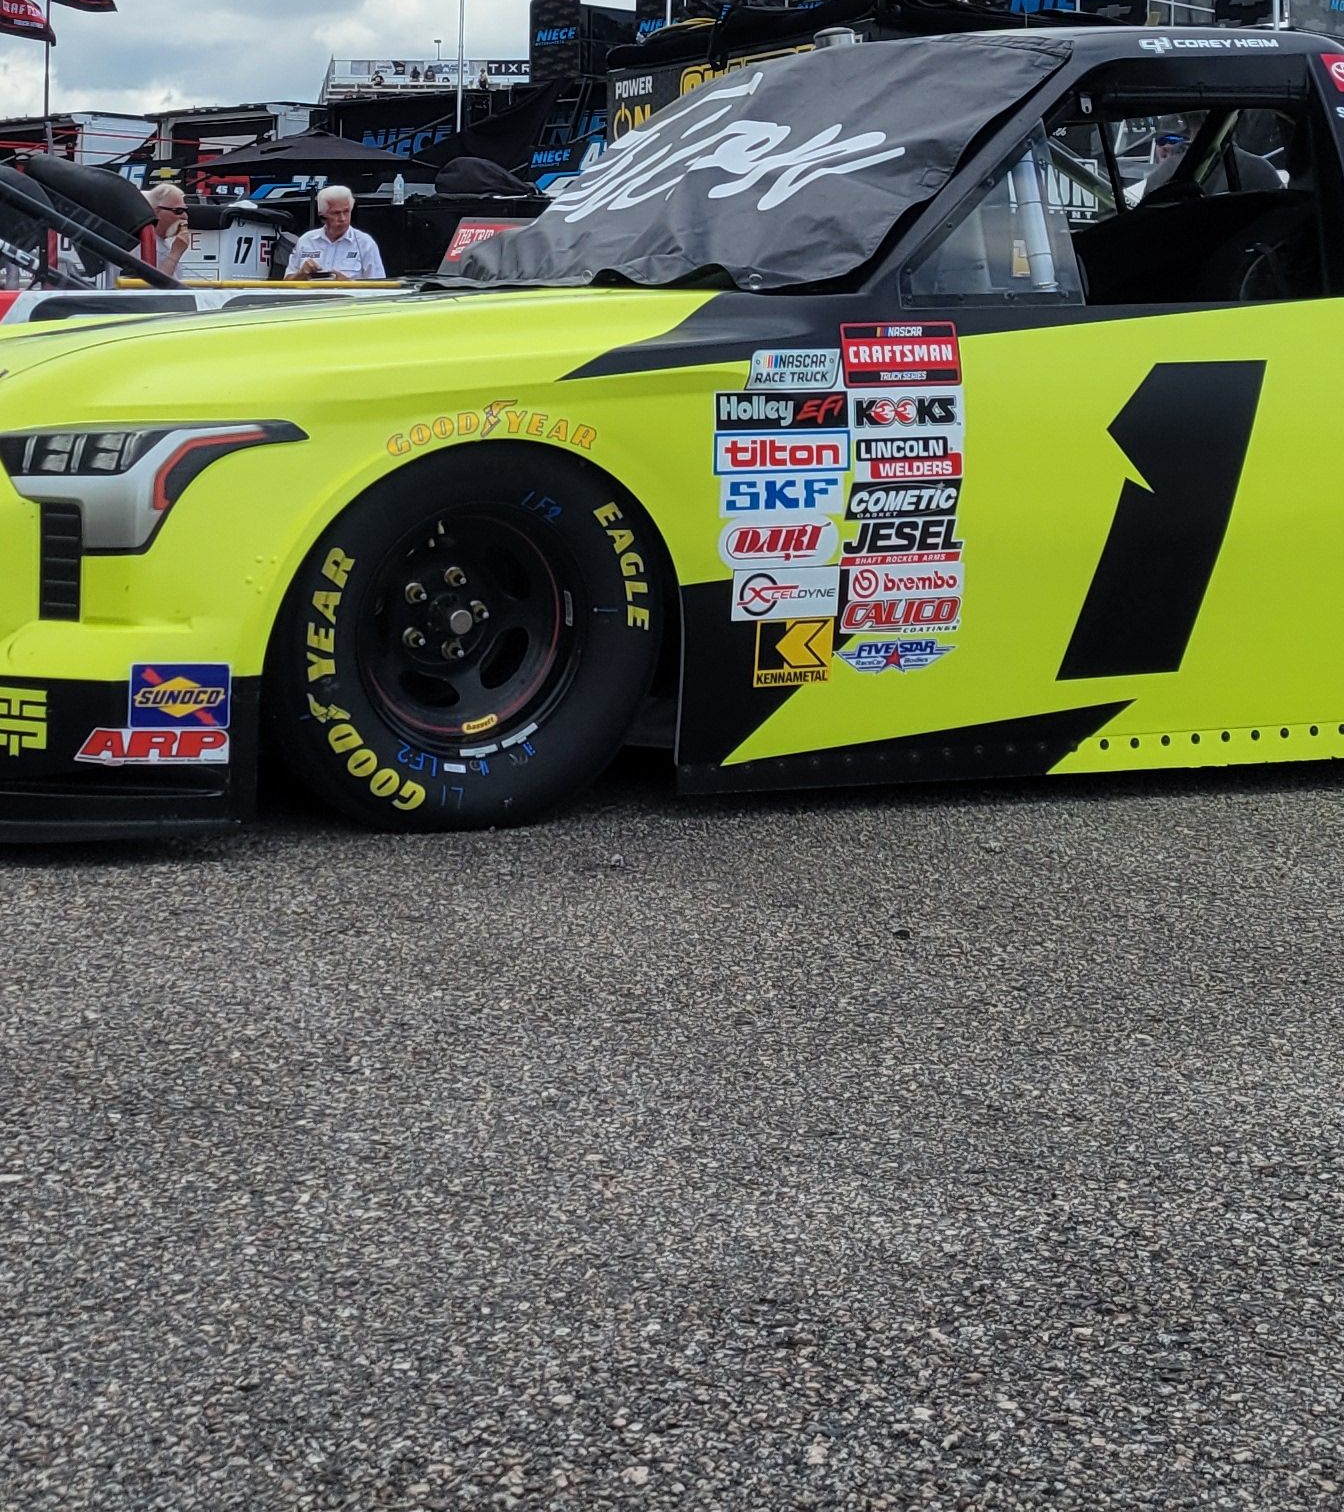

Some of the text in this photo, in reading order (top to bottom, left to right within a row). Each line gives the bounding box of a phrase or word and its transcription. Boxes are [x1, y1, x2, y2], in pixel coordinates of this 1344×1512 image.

[536, 27, 577, 42] NIECE
[1173, 38, 1279, 49] COREY HEIM
[615, 75, 654, 101] POWER
[532, 149, 571, 164] NIECE
[234, 236, 254, 264] 17
[887, 326, 923, 337] NASCAR
[778, 354, 826, 368] NASCAR
[848, 344, 953, 364] CRAFTSMAN
[755, 371, 829, 384] RACE TRUCK
[880, 371, 927, 381] TRUCK SERIES
[719, 394, 844, 426] Holley EFI
[854, 396, 957, 428] KOOKS
[387, 400, 597, 456] GOODYEAR
[724, 439, 840, 468] tilton
[860, 439, 944, 459] LINCOLN
[879, 460, 953, 477] WELDERS
[725, 478, 839, 511] SKF
[850, 487, 958, 513] COMETIC
[856, 511, 898, 519] GASKET
[1056, 360, 1268, 680] 1
[842, 519, 962, 555] JESEL
[592, 501, 650, 631] EAGLE
[855, 553, 946, 565] SHAFT ROCKER ARMS
[883, 570, 958, 592] brembo
[736, 584, 836, 607] XCELDYNE
[841, 596, 961, 630] CALICO
[902, 624, 957, 634] COATINGS
[857, 640, 936, 658] FIVE STAR
[856, 656, 929, 667] RaceCar Bodies
[306, 547, 427, 811] GOODYEAR
[756, 670, 829, 685] KENNAMETAL
[138, 690, 223, 705] SUNOCO
[80, 730, 228, 758] ARP
